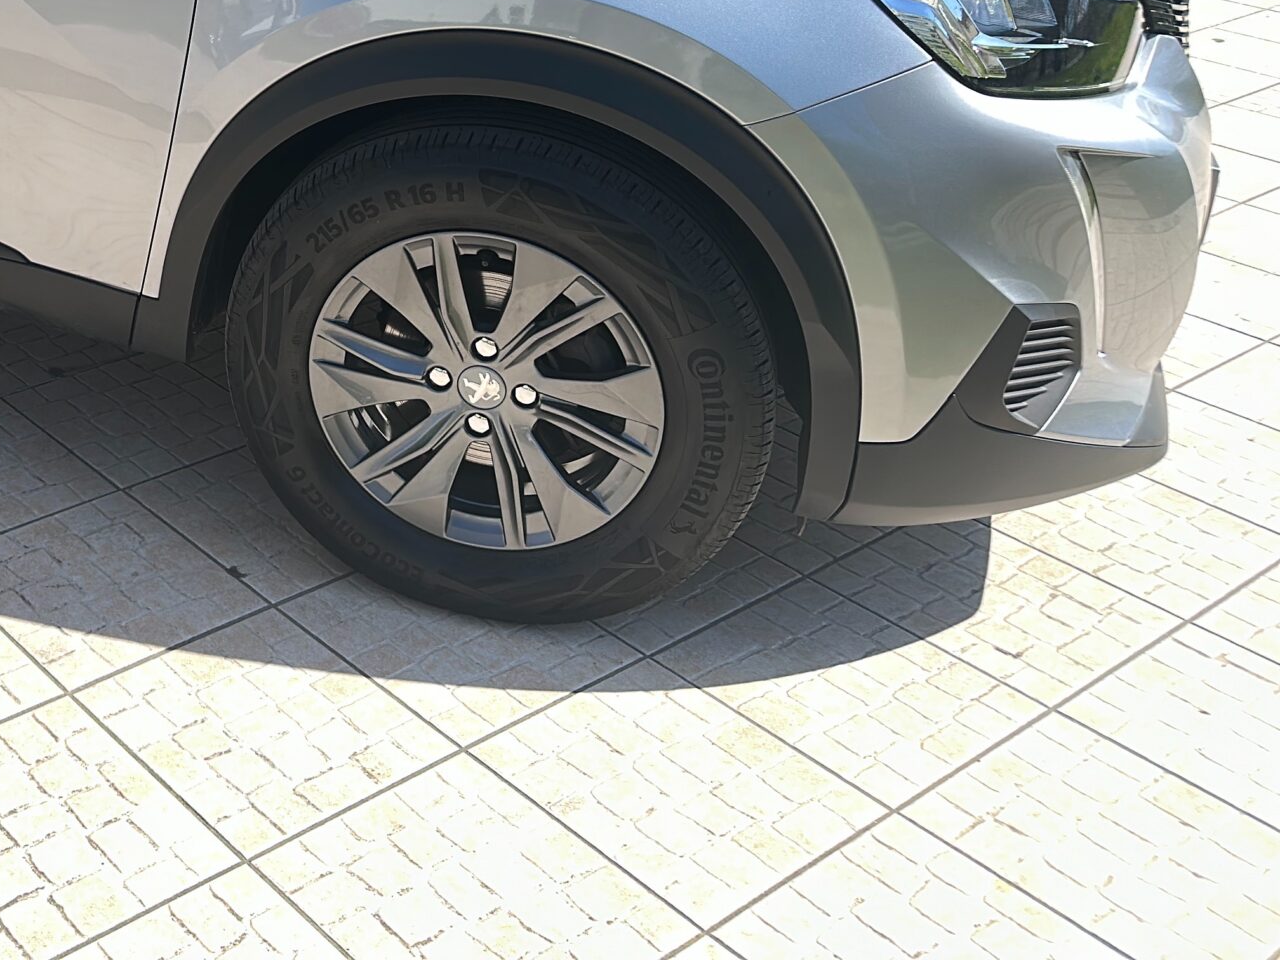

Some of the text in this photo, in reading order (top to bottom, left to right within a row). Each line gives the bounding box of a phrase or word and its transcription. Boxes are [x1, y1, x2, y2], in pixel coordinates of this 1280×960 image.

[305, 181, 465, 254] 215/65 R 16 H
[680, 347, 734, 519] Continental
